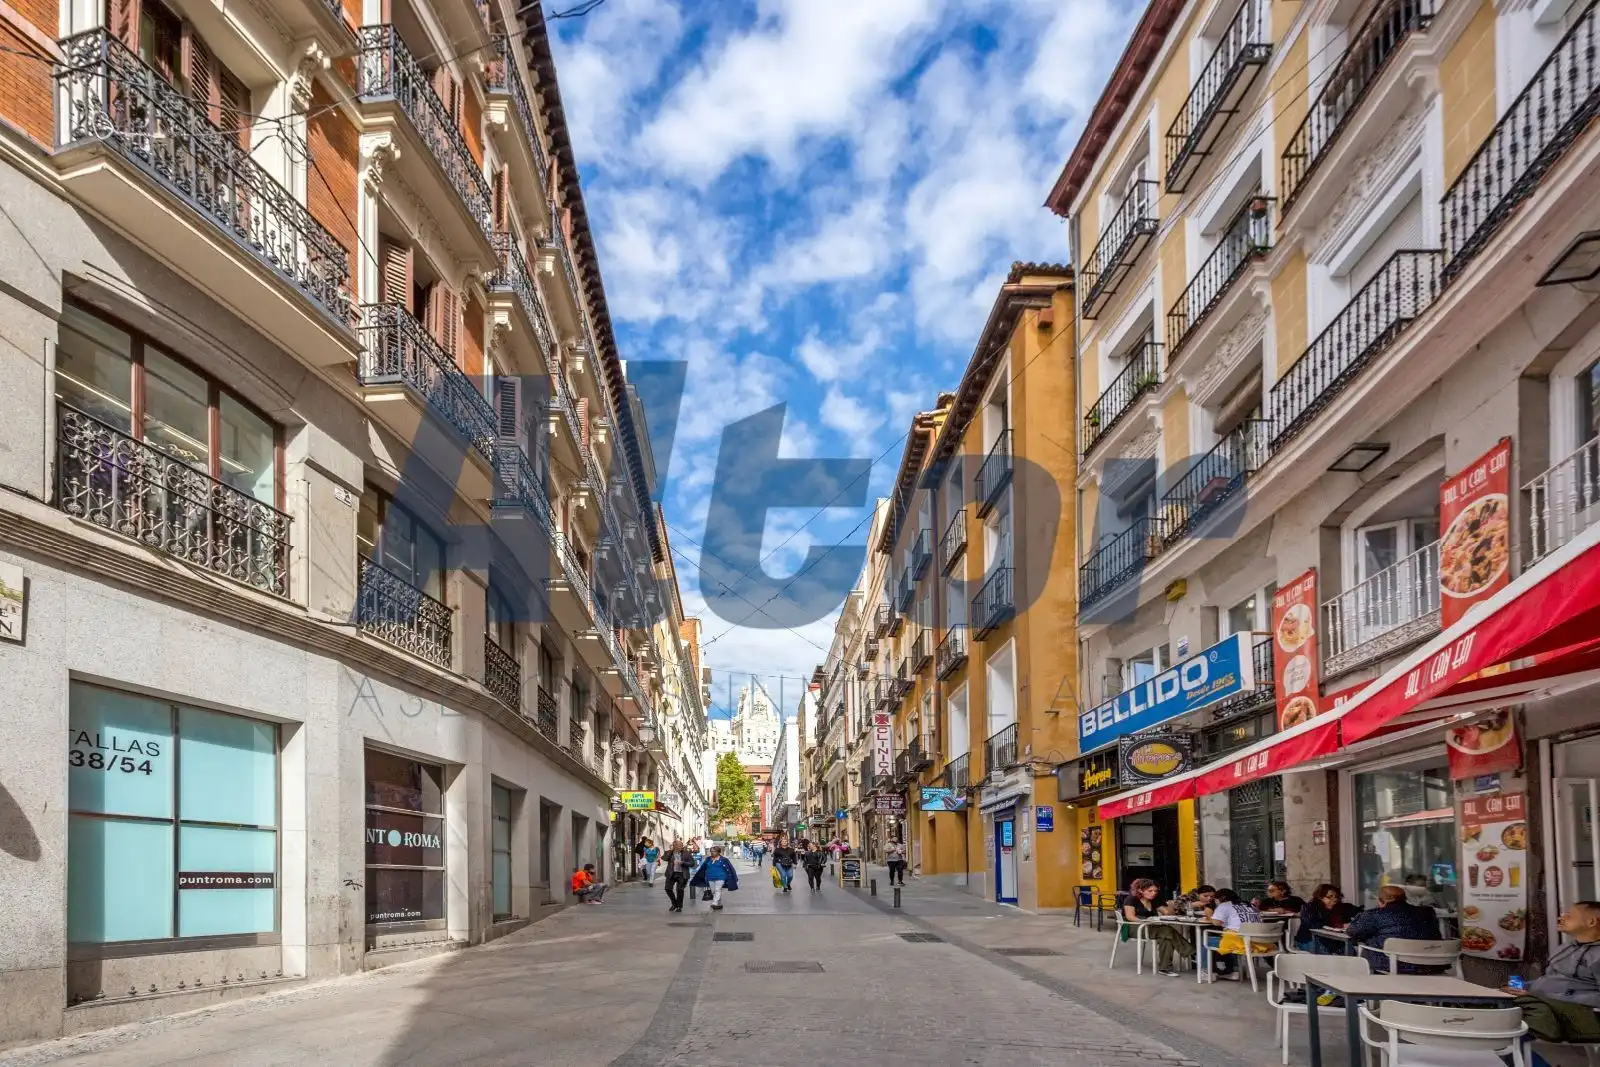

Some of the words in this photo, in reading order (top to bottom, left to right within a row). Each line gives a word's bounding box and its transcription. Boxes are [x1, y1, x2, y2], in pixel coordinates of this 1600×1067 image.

[1469, 464, 1487, 489] CAN
[1404, 668, 1421, 700] ALL
[1431, 647, 1453, 684] CAN
[1452, 631, 1477, 670] EAT
[1081, 655, 1209, 738] BELLIDO
[69, 728, 160, 757] ALLAS
[876, 727, 889, 776] CLINICA
[69, 749, 153, 776] 38/54
[1486, 797, 1503, 813] CAN
[404, 832, 441, 849] ROMA
[179, 876, 272, 885] puntroma.com
[370, 910, 421, 920] puntroma.com
